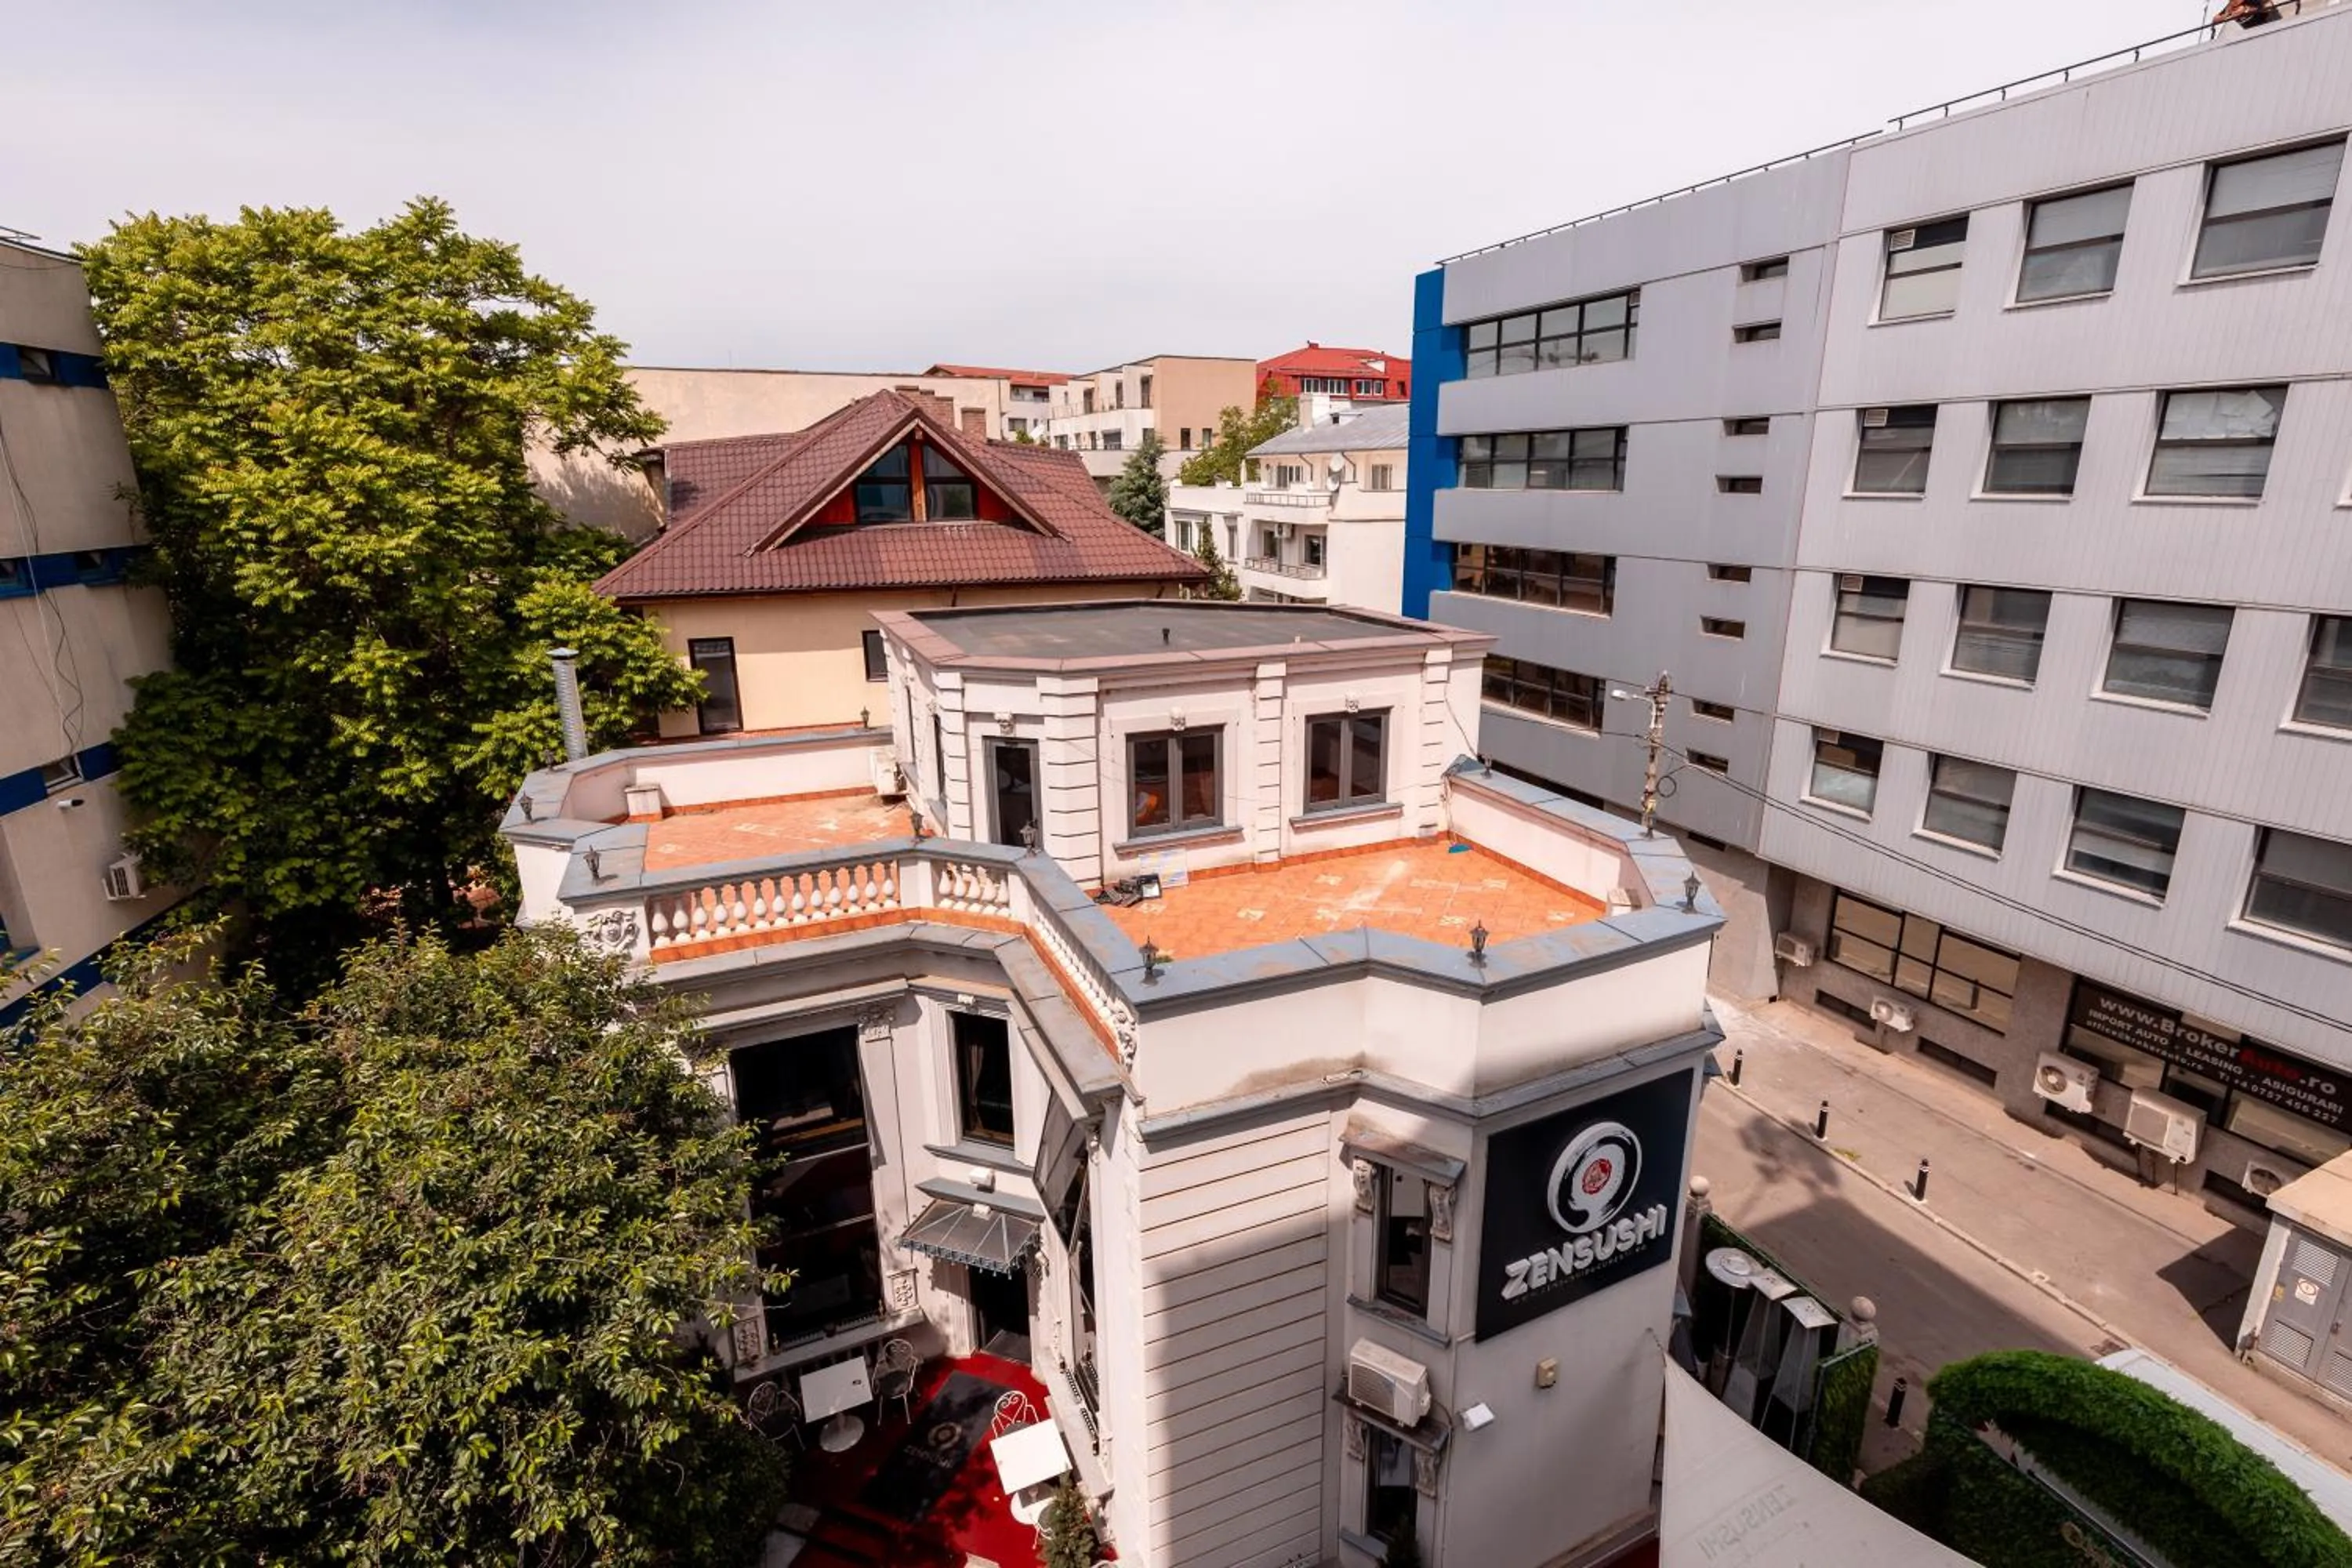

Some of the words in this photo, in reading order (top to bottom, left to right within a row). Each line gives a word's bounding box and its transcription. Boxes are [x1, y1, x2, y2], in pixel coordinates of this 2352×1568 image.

[2089, 1008, 2133, 1032] IMPORT
[2135, 1028, 2169, 1046] AUTO
[2185, 1047, 2243, 1075] LEASING
[2262, 1076, 2344, 1114] ASIGURARI
[1501, 1203, 1668, 1300] ZENSUSHI
